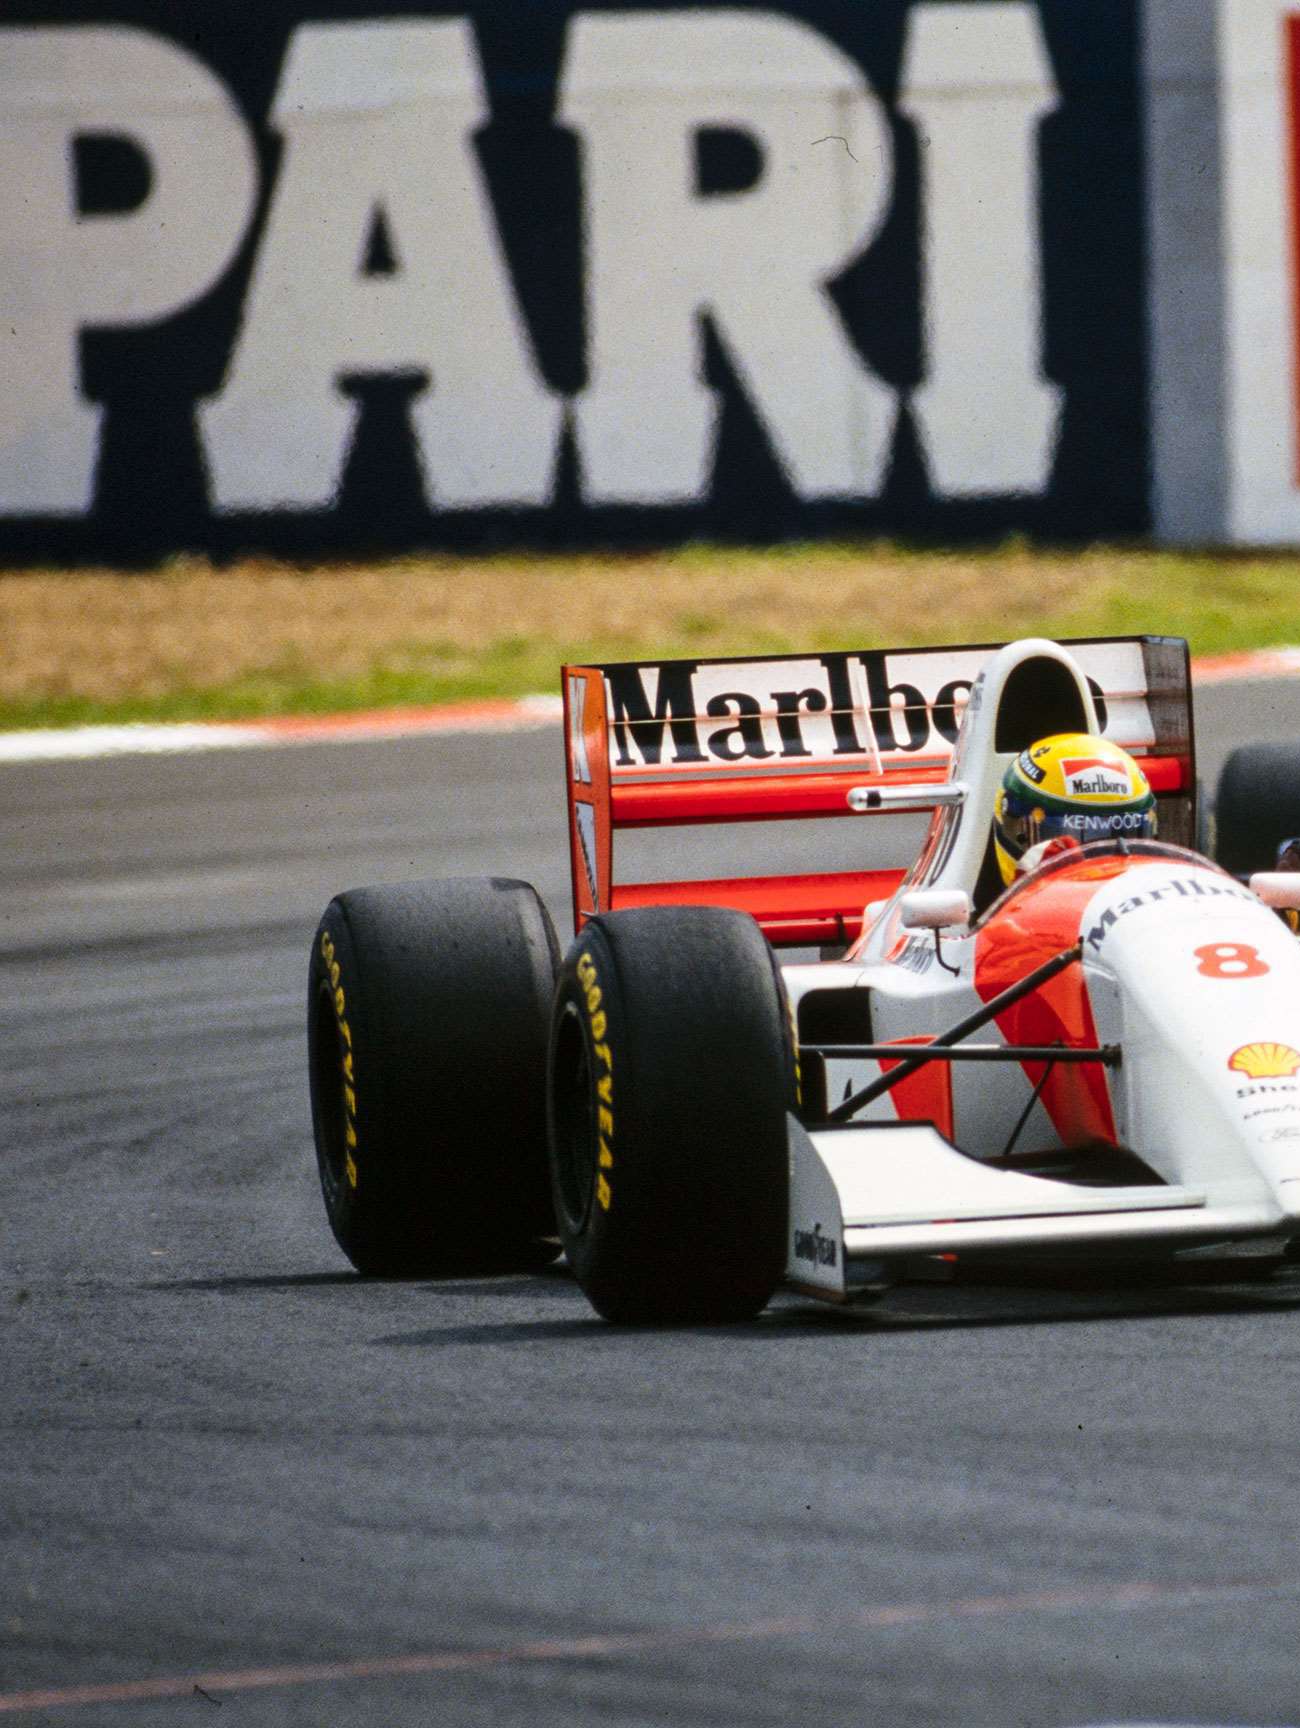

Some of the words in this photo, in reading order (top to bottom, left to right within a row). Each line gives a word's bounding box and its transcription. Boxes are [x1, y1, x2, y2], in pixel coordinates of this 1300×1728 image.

[0, 2, 1062, 516] PARI
[1072, 774, 1128, 794] Marlboro
[1063, 812, 1142, 830] KENWOOD
[1193, 942, 1271, 979] 8
